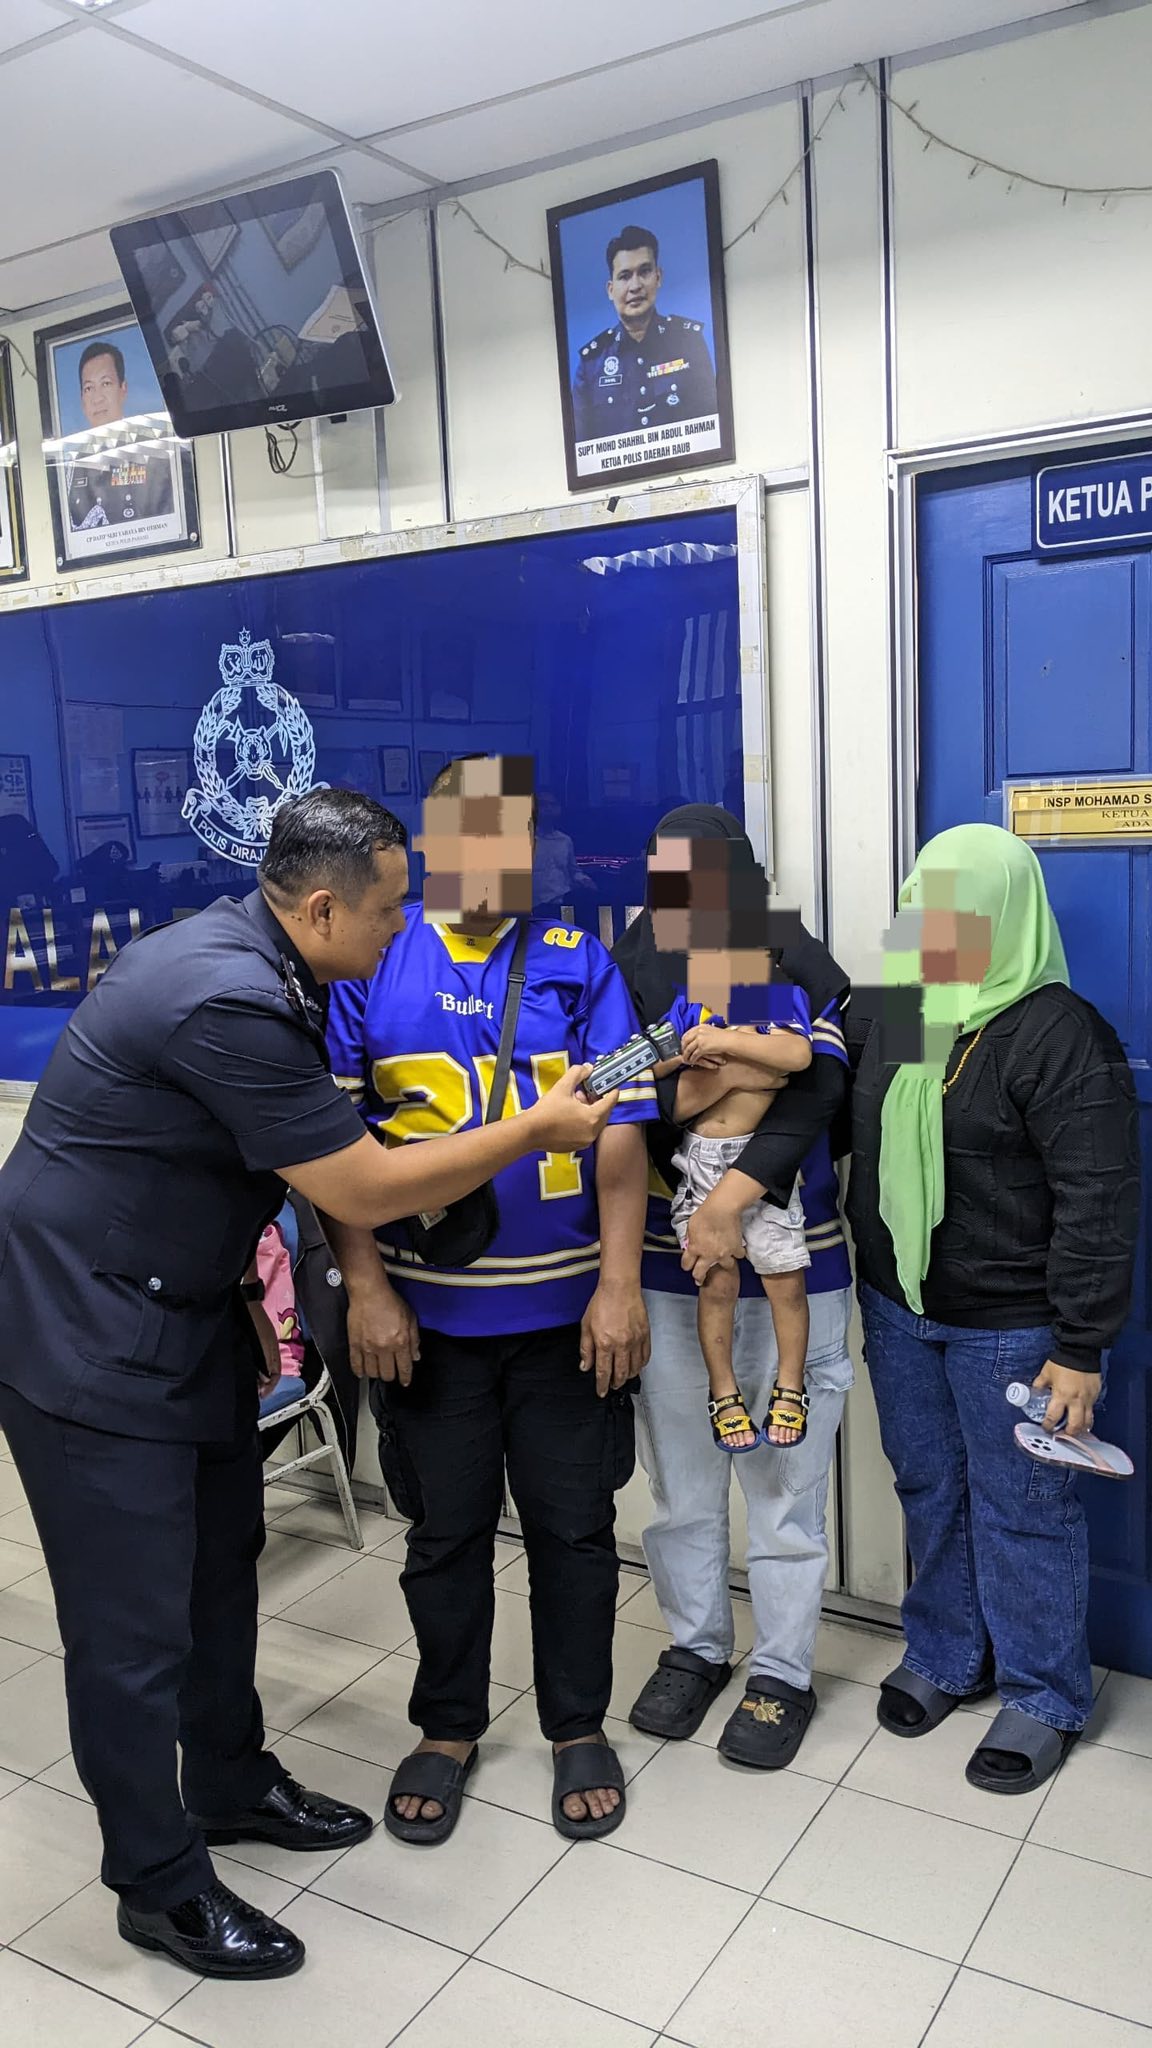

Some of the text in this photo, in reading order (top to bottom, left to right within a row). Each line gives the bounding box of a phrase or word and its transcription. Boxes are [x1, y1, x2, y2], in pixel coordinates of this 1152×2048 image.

[577, 420, 715, 457] SUPT MOHD SHAHRIL BIN ABDUL RAHMAN
[601, 442, 691, 469] KETUA POLIS DAERAH RAUB
[1048, 480, 1133, 524] KETUA
[1044, 797, 1071, 808] INSP
[1074, 794, 1140, 807] MOHAMAD
[1102, 809, 1149, 819] KETUA
[198, 820, 227, 850] POLIS
